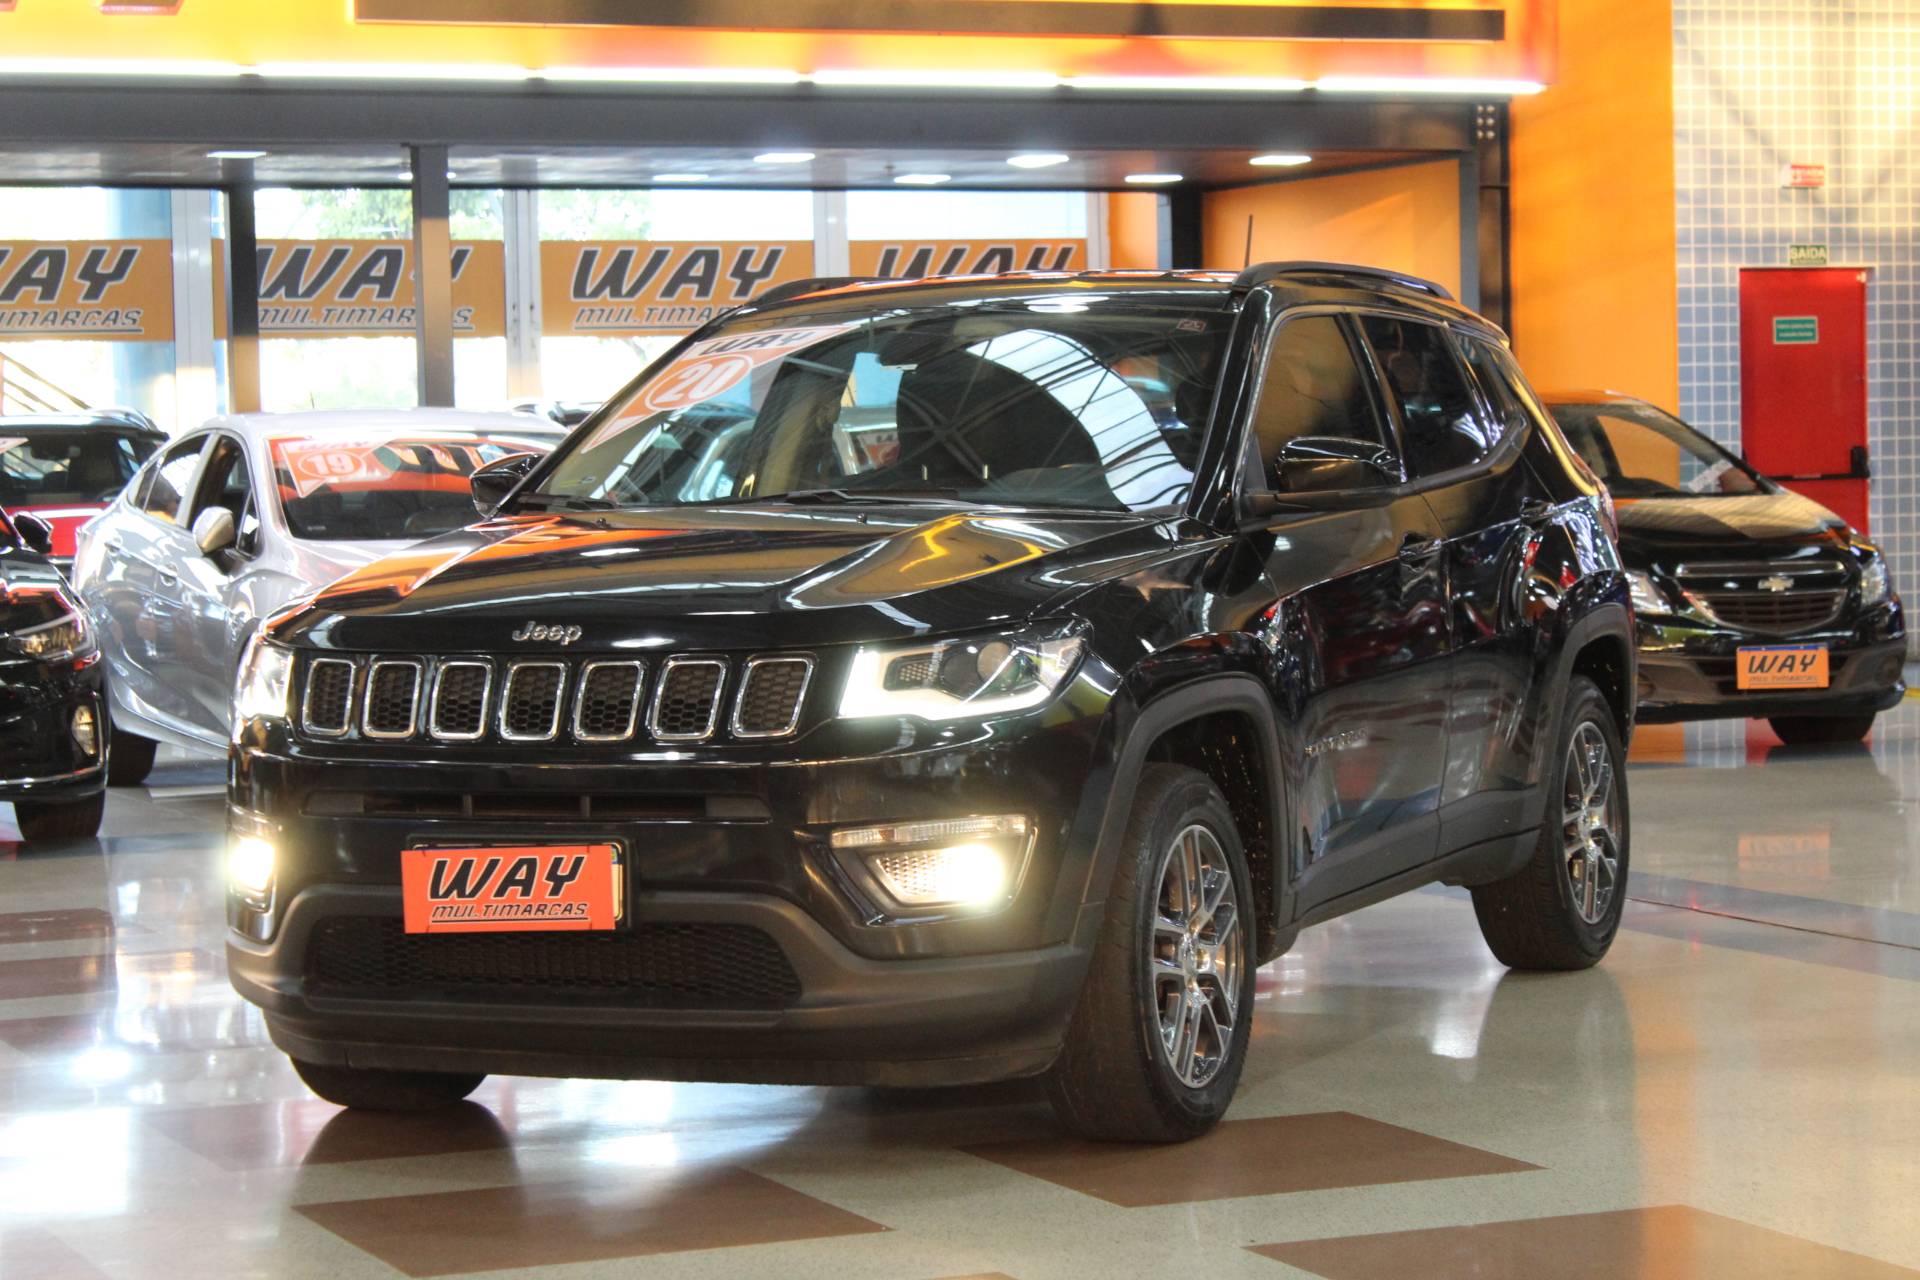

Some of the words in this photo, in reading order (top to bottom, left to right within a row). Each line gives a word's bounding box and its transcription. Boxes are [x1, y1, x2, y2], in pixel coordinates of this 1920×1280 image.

[0, 246, 141, 304] AY
[570, 246, 786, 301] WAY
[700, 331, 818, 355] WAY
[652, 356, 747, 404] 20
[309, 453, 355, 475] 19
[511, 620, 582, 646] Jeep
[1748, 654, 1817, 674] WAY
[428, 855, 588, 902] WAY
[431, 902, 589, 919] MULTIMARCAS
